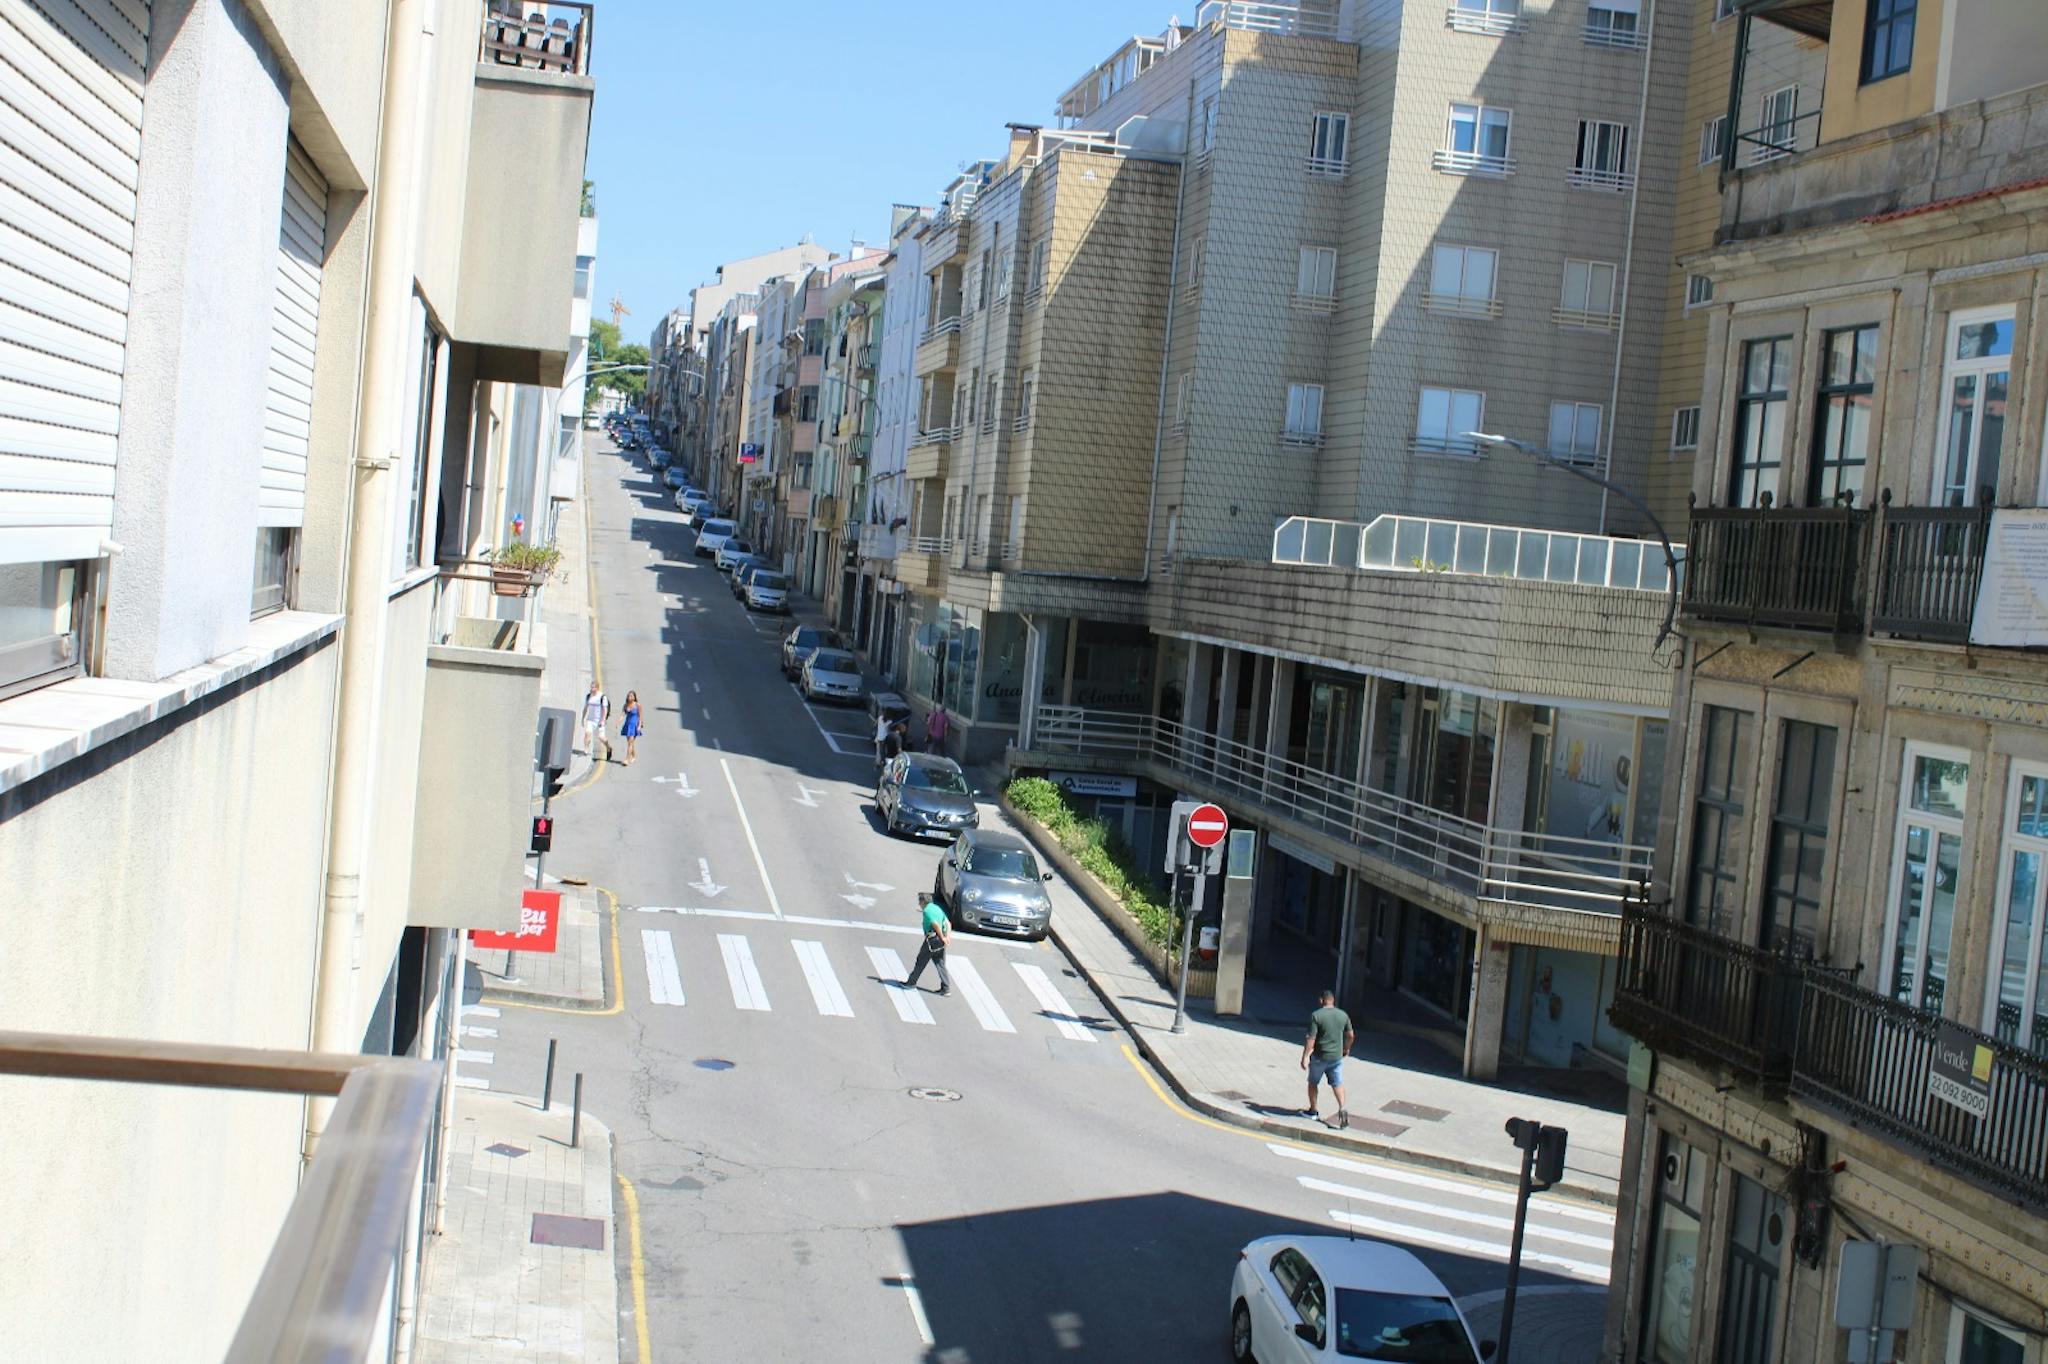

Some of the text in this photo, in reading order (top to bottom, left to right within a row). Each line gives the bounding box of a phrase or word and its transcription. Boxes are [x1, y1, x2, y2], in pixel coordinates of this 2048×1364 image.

[744, 444, 753, 454] P
[521, 908, 547, 924] eu
[1938, 1040, 1968, 1071] Vende
[1932, 1075, 1941, 1090] 22
[1942, 1081, 1959, 1100] 092
[1961, 1090, 1985, 1111] 9000
